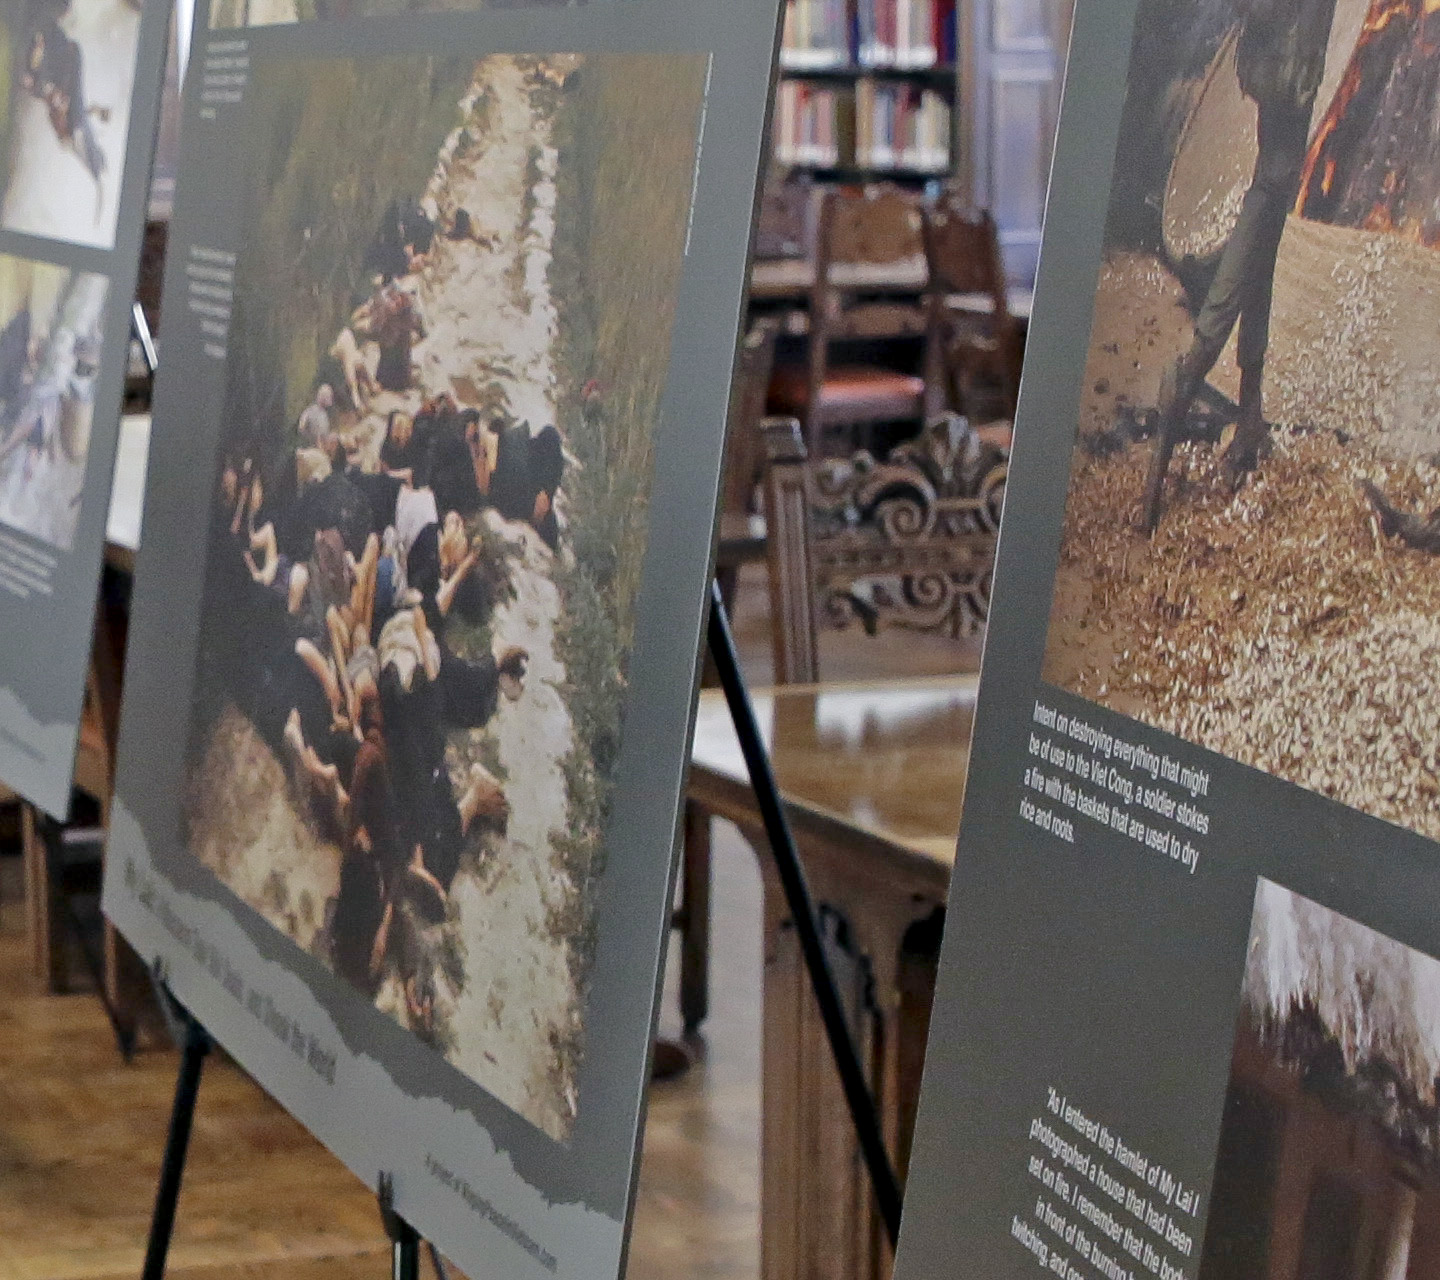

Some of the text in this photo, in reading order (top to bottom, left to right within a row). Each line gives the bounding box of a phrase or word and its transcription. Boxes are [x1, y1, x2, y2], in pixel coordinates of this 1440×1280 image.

[1029, 732, 1210, 835] be of use to the Viet Cong, a soldier stokes
[1033, 700, 1210, 797] Intent on destroying everything that might
[1019, 797, 1075, 844] rice and roots.
[1024, 767, 1200, 875] a fire with the baskets that are used to dry
[1029, 1117, 1192, 1257] photographed a house that had been
[1060, 1097, 1067, 1118] I
[1065, 1105, 1100, 1144] entered
[1099, 1125, 1115, 1155] the
[1114, 1137, 1148, 1180] hamlet
[1147, 1165, 1161, 1188] of
[1158, 1170, 1176, 1205] My
[1175, 1182, 1194, 1214] Lai
[1192, 1193, 1200, 1218] I
[1010, 1215, 1049, 1267] twitching,
[1049, 1252, 1069, 1280] and
[1028, 1155, 1044, 1180] set
[1042, 1167, 1055, 1189] on
[1071, 1185, 1079, 1206] I
[1077, 1194, 1124, 1244] remember
[1123, 1228, 1143, 1261] that
[1142, 1243, 1160, 1273] the
[1035, 1195, 1045, 1220] in
[1044, 1202, 1067, 1237] front
[1065, 1224, 1077, 1245] of
[1075, 1230, 1091, 1258] the
